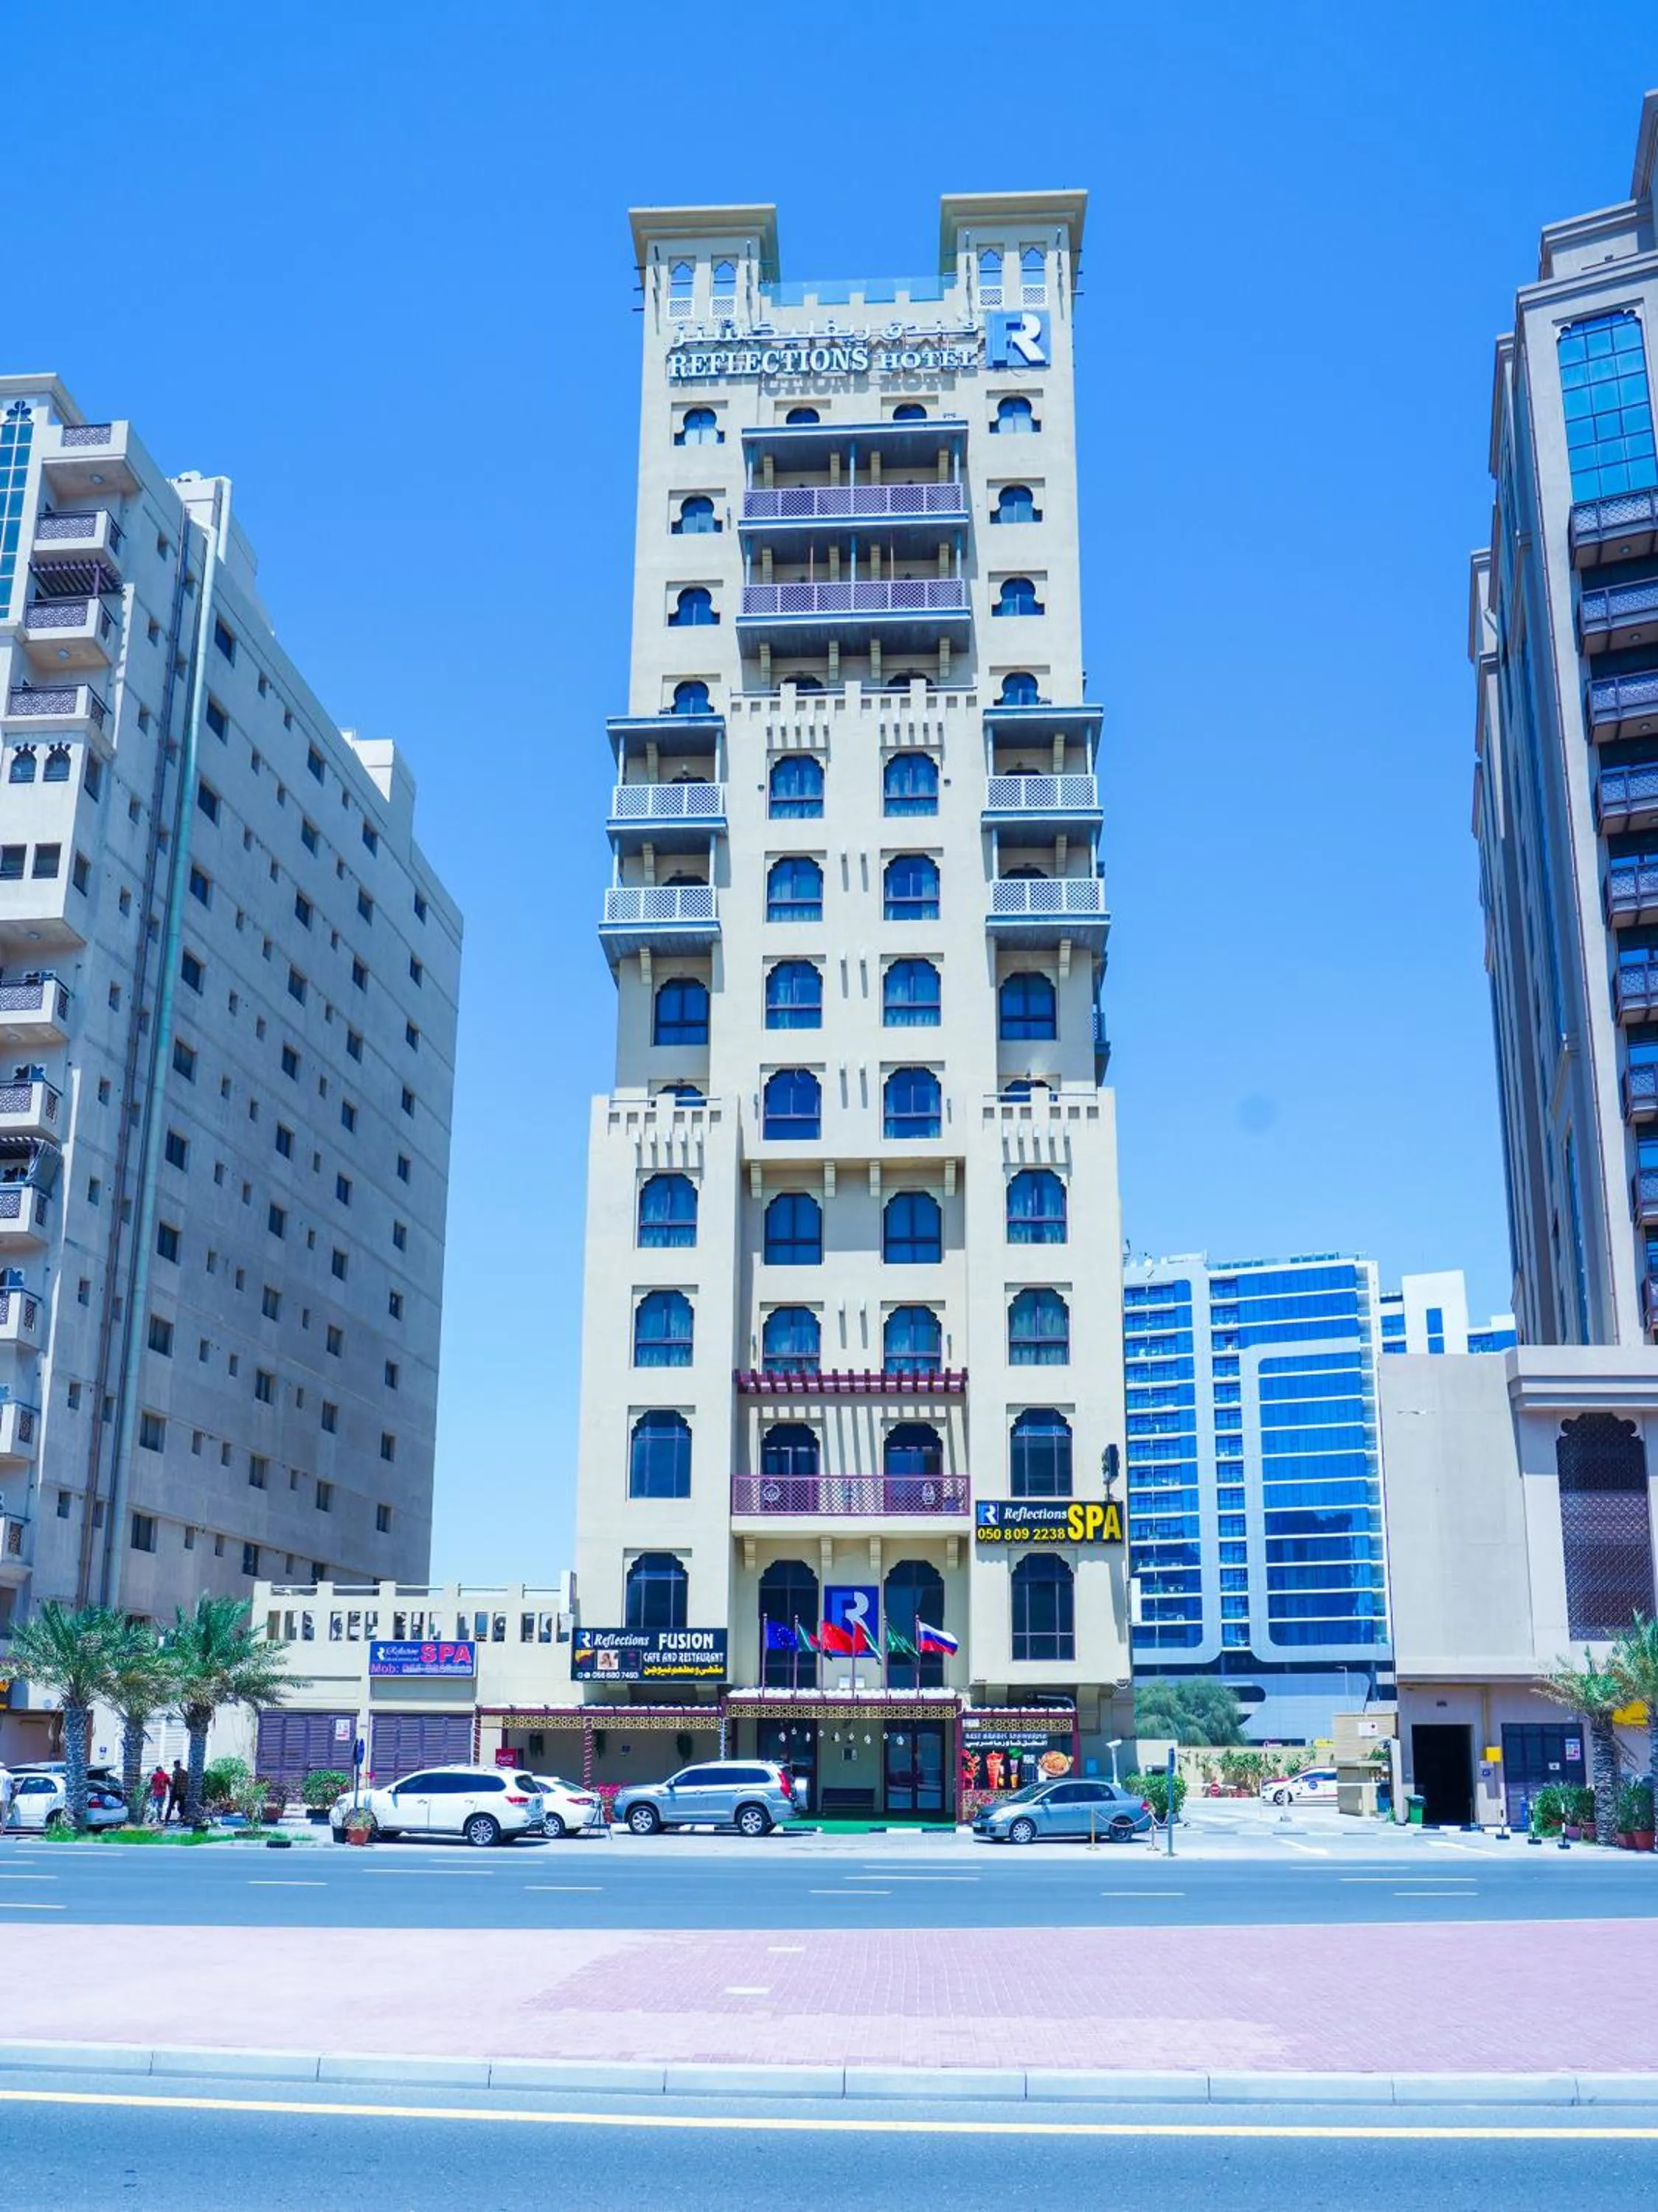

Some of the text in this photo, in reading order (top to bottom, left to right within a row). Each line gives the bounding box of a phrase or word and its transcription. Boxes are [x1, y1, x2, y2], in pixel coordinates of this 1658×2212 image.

[668, 347, 977, 378] REFLECTIONS HOTEL
[1004, 1503, 1122, 1541] Reflections SPA
[977, 1528, 1002, 1540] 050
[1033, 1528, 1066, 1540] 2238
[594, 1632, 713, 1650] Reflections FUSION
[420, 1643, 472, 1664] SPA
[643, 1652, 724, 1663] CAFE AND RESTAURANT
